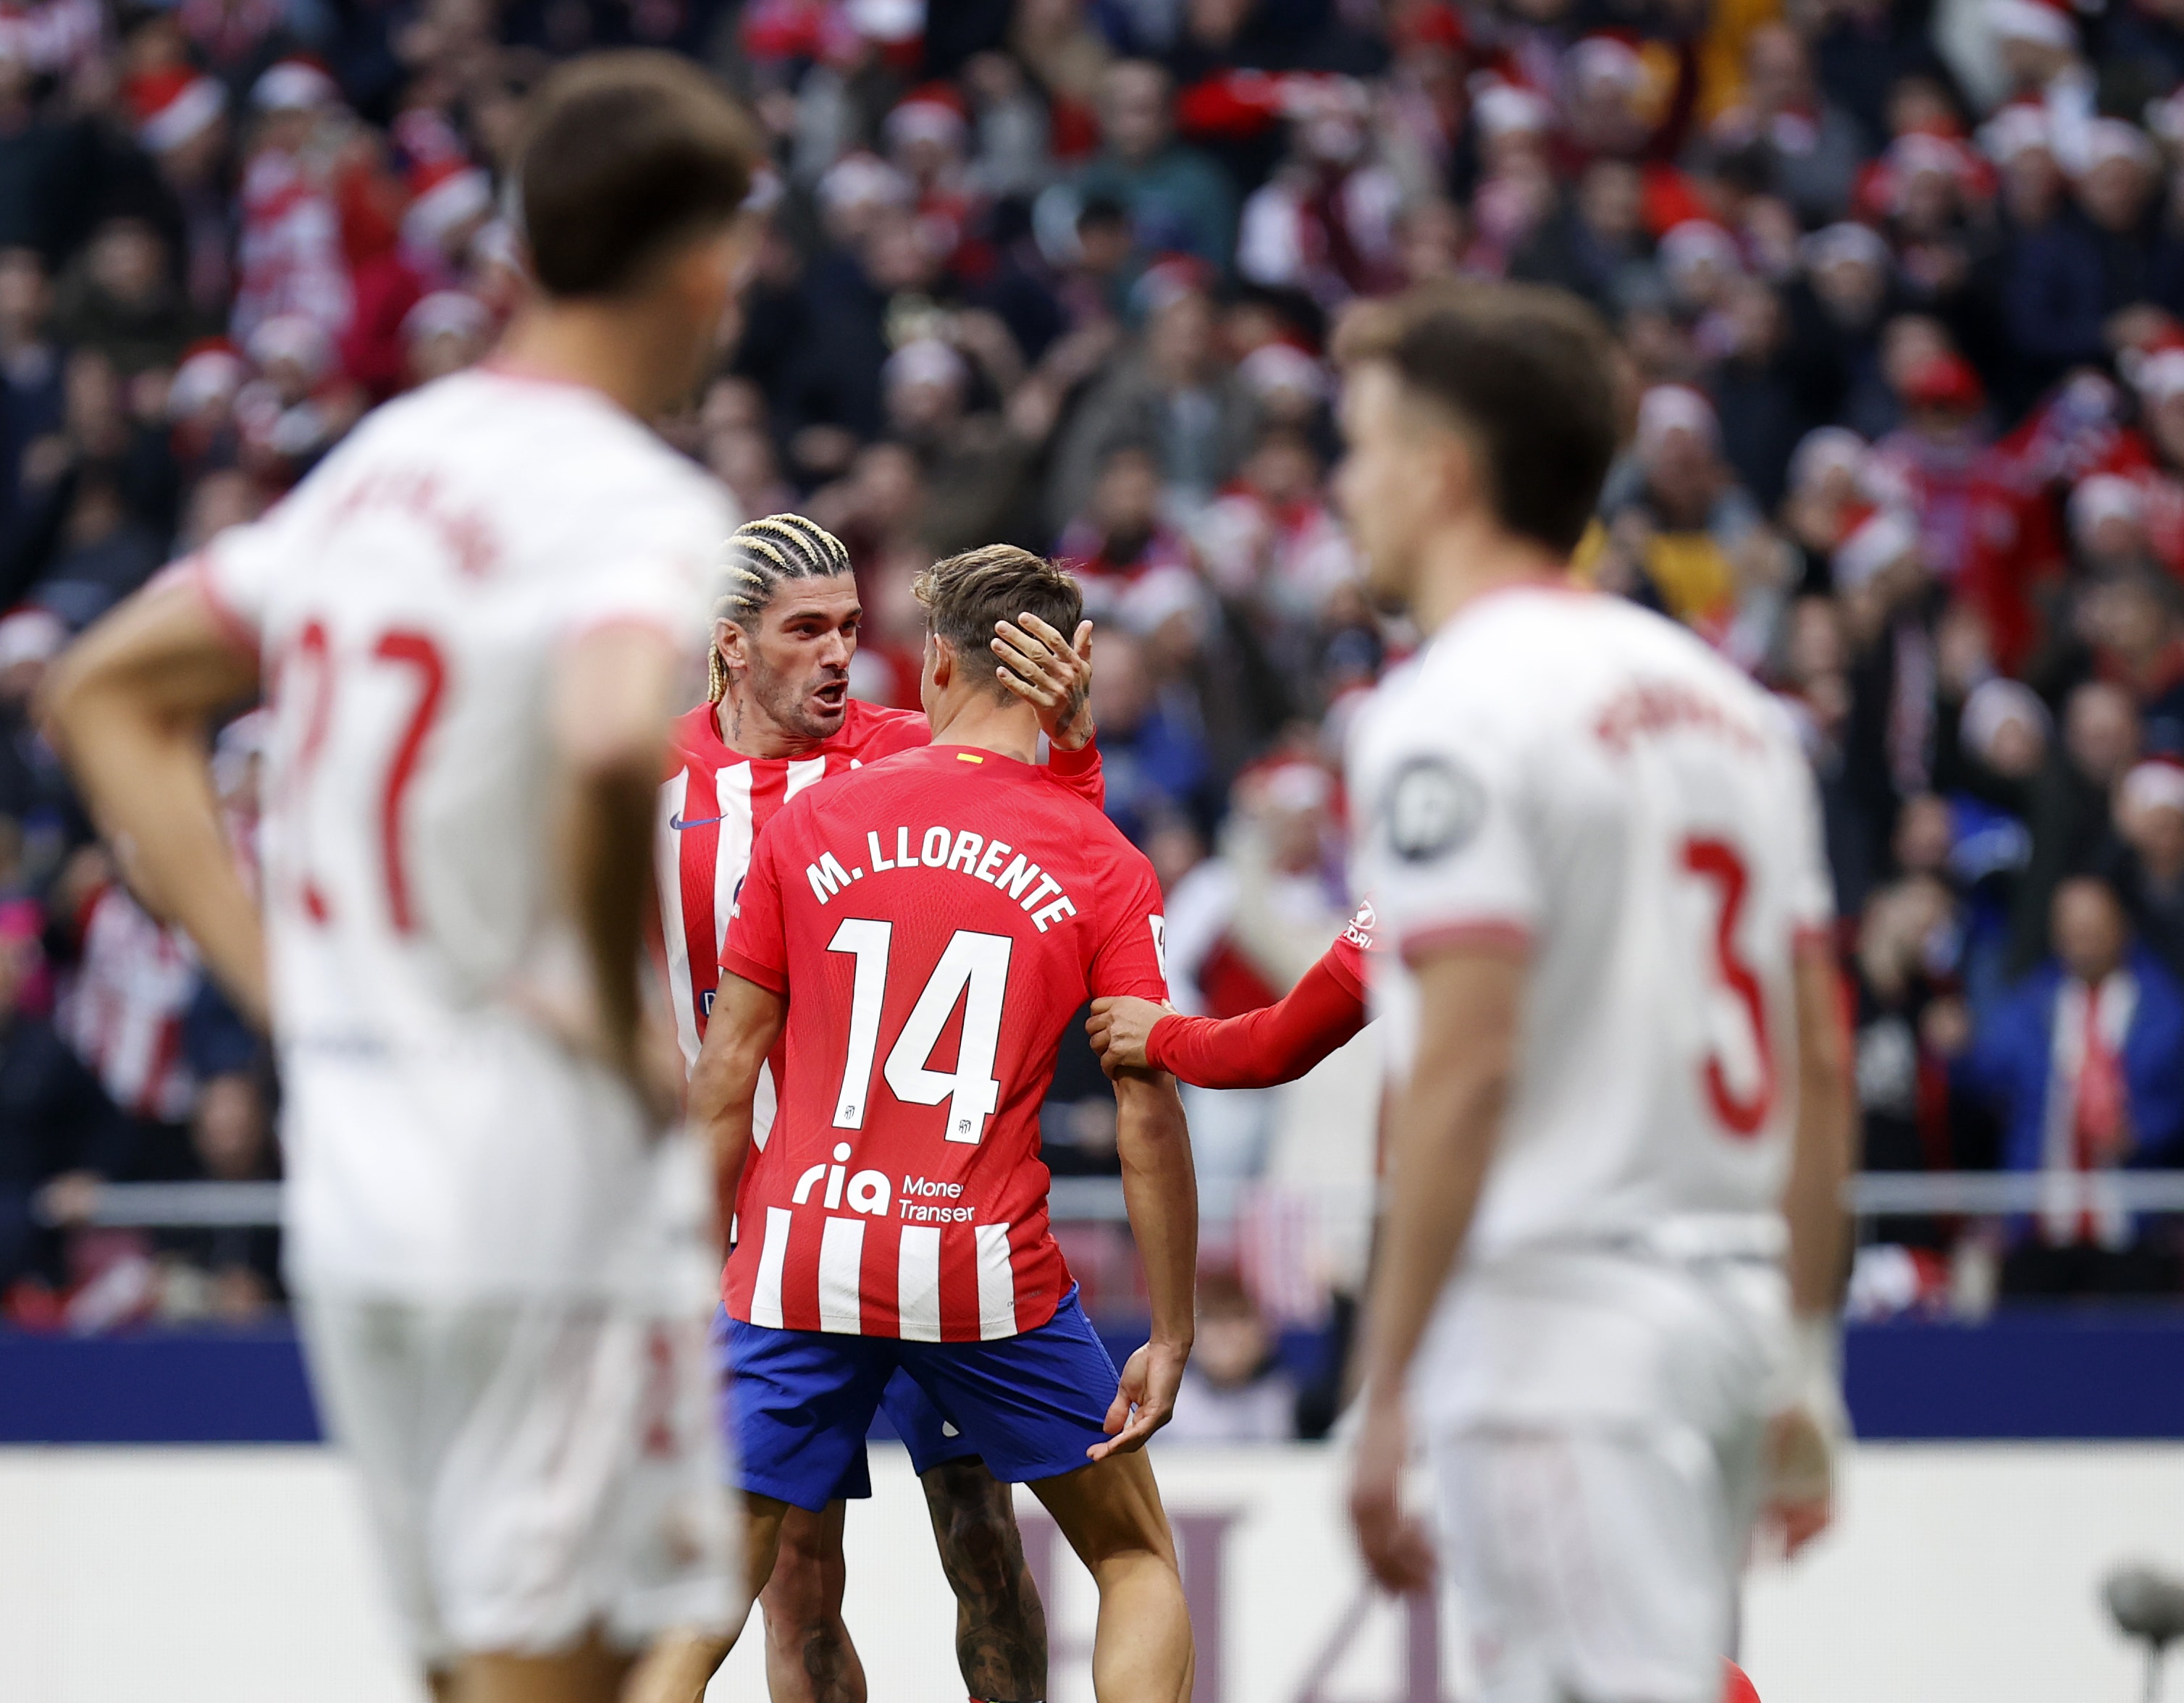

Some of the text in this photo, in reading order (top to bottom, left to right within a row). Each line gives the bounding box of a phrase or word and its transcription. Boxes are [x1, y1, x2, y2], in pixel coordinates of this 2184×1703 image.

[805, 825, 1078, 934] M. LLORENTE
[824, 916, 1013, 1145] 14
[1678, 834, 1778, 1138] 3
[791, 1141, 892, 1217] ria
[898, 1198, 975, 1224] Transer
[902, 1174, 965, 1199] Mone
